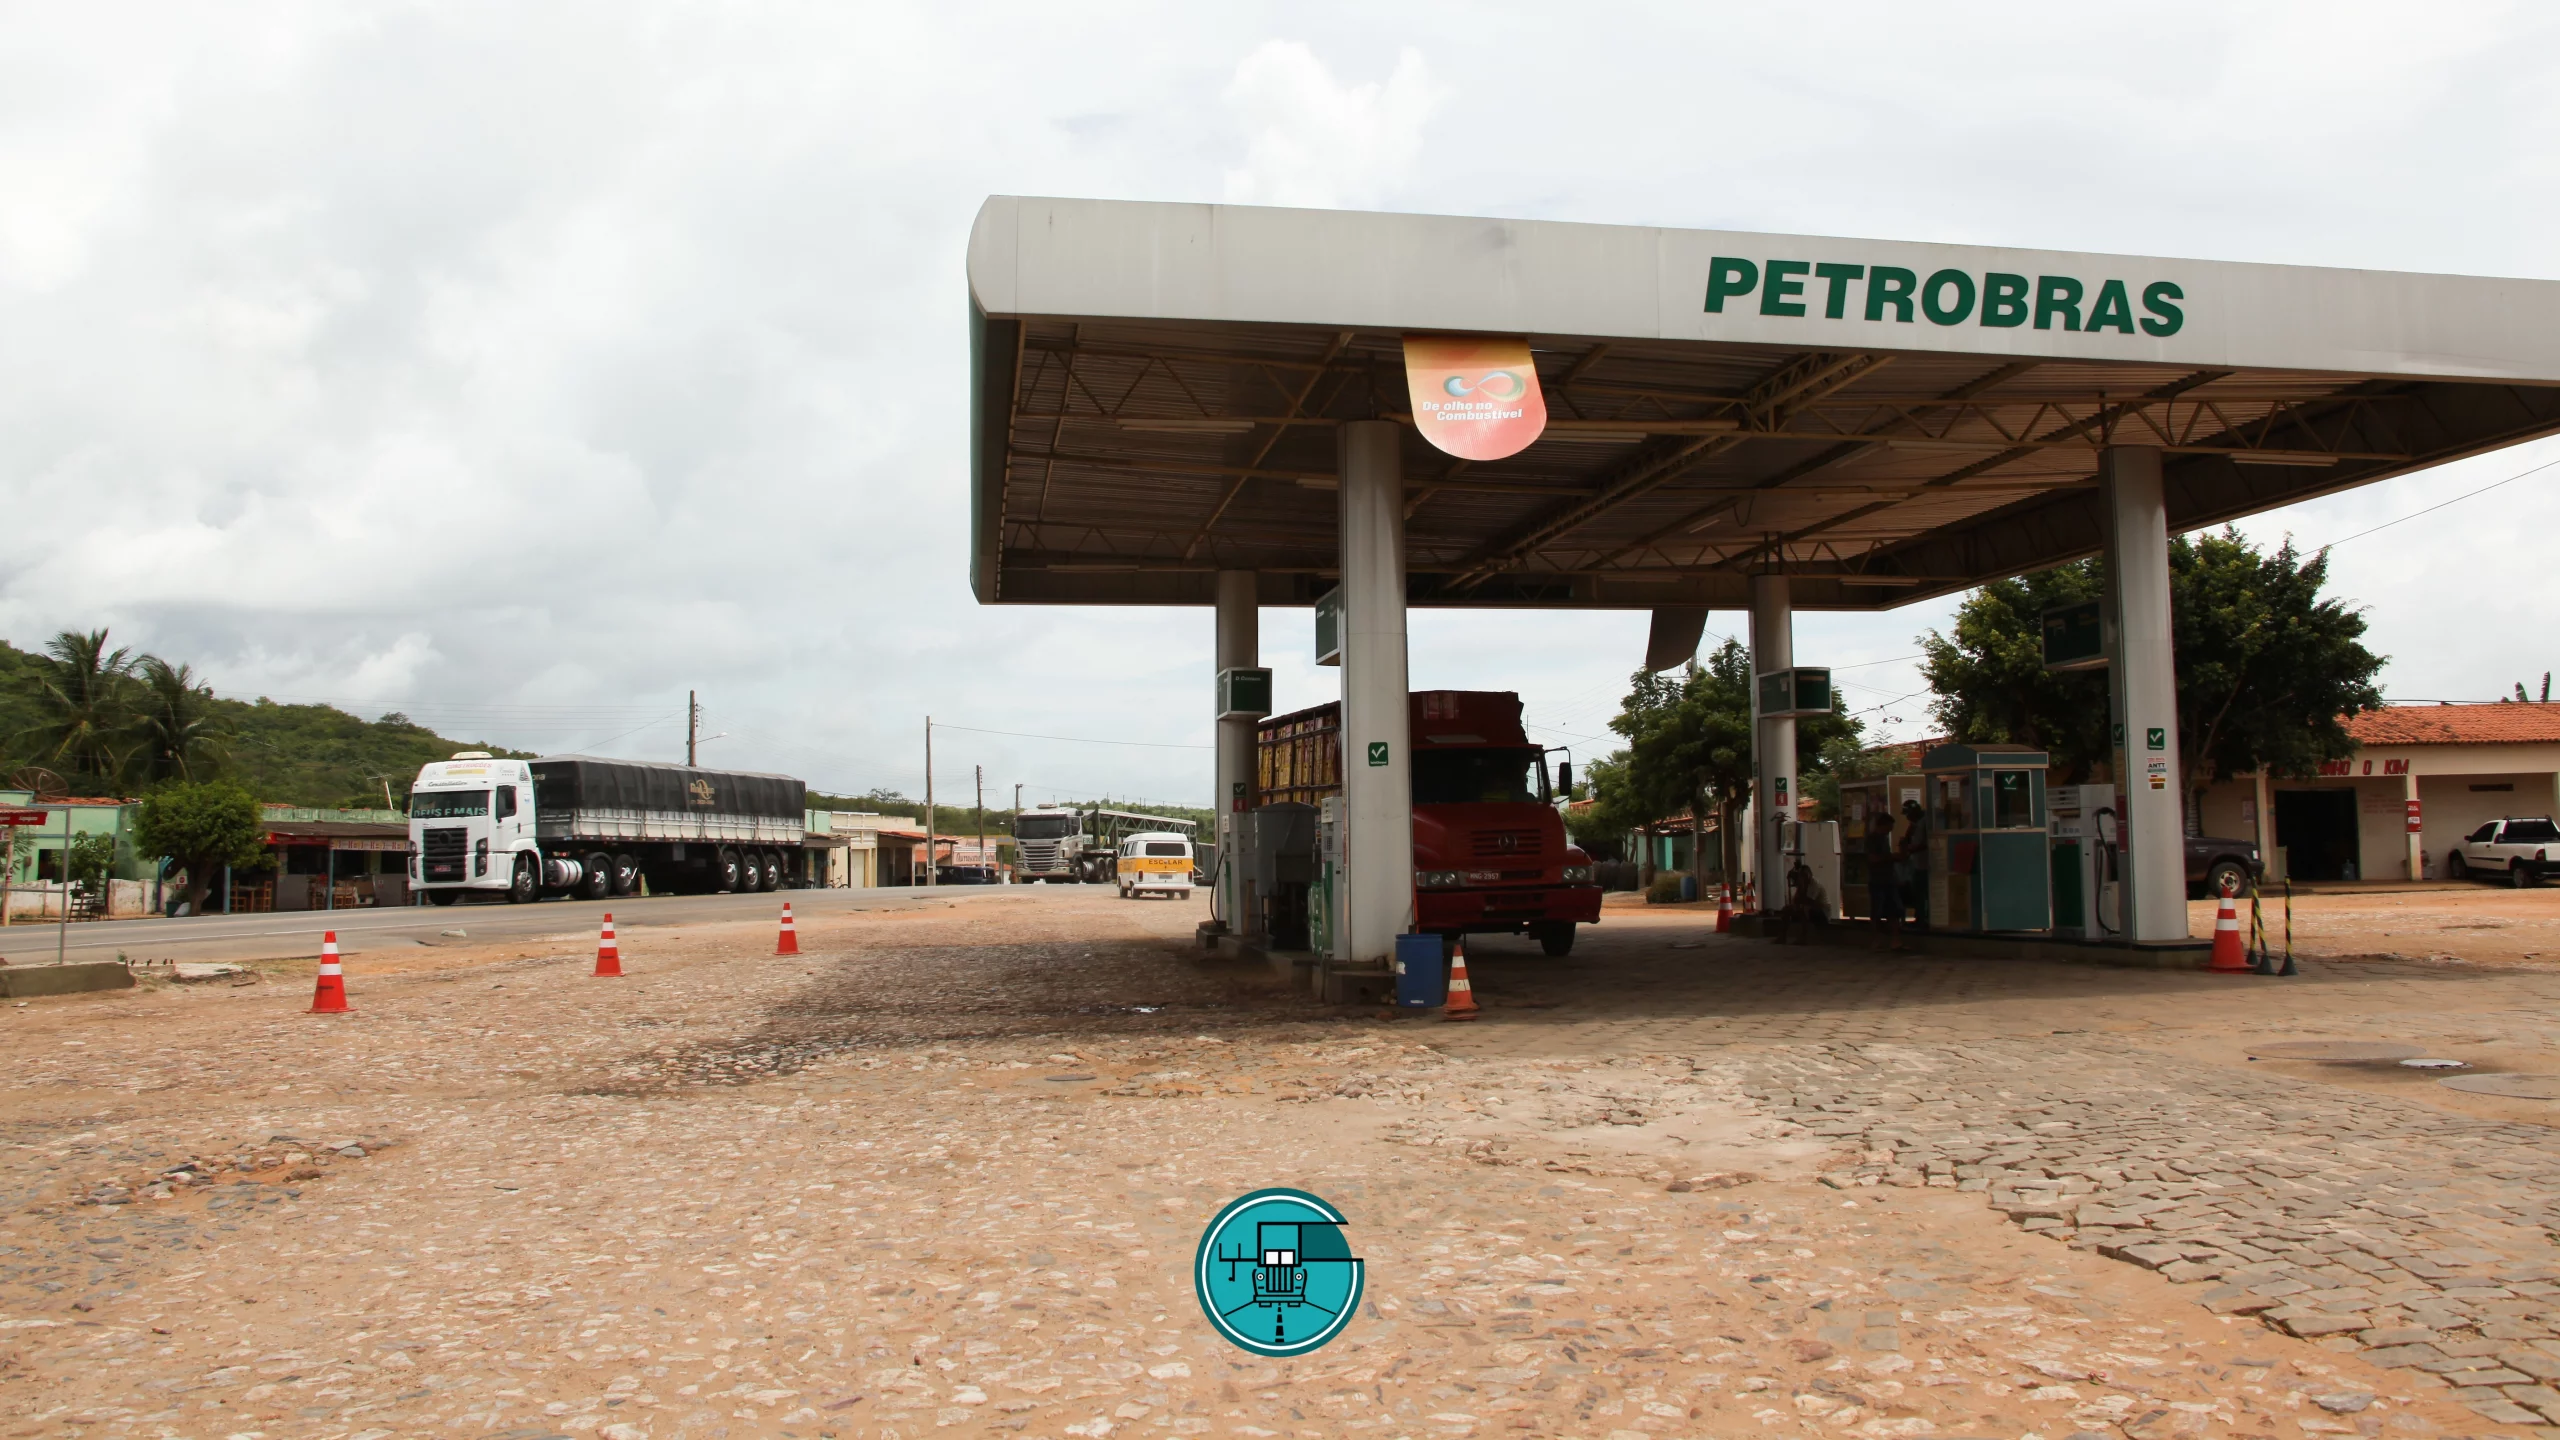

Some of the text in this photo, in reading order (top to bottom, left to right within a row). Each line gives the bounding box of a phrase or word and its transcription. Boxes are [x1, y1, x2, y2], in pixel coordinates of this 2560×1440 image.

[1703, 256, 2185, 338] PETROBRAS
[1422, 400, 1493, 411] De olho no
[1436, 408, 1523, 421] Combustível
[2384, 758, 2410, 775] KIM
[453, 806, 488, 817] MAIS
